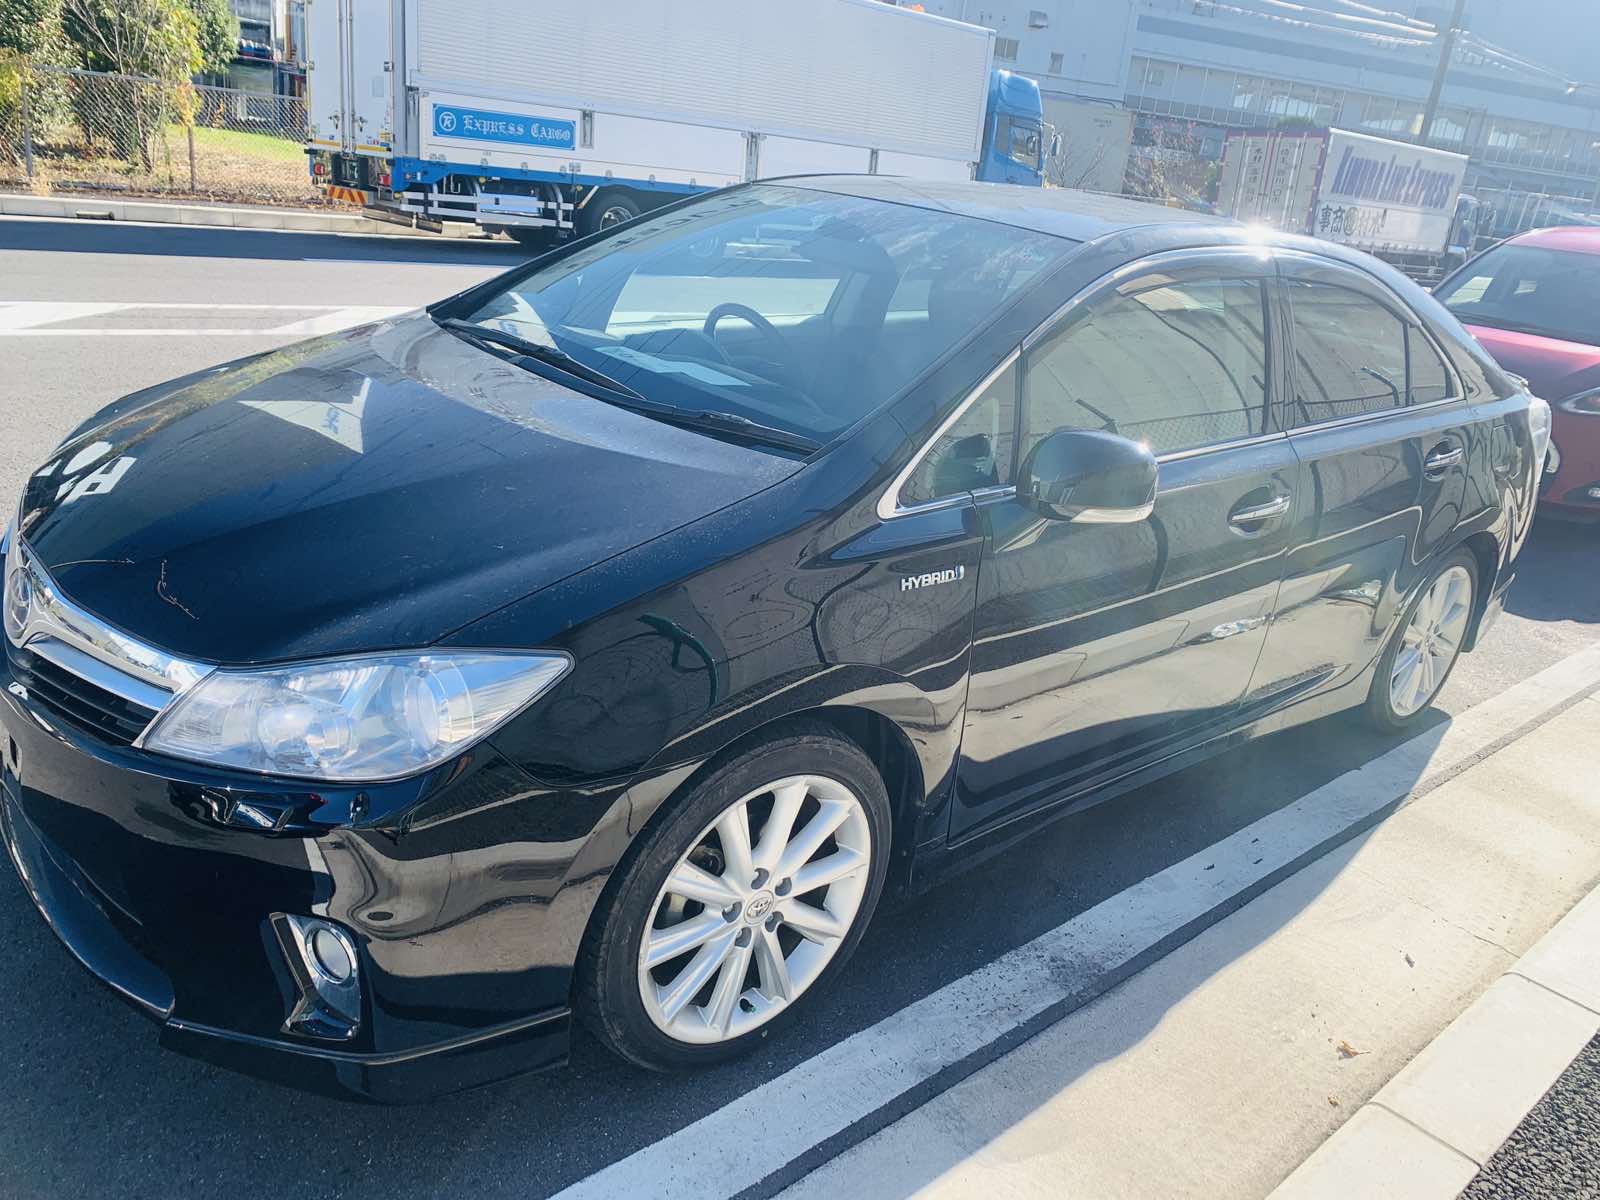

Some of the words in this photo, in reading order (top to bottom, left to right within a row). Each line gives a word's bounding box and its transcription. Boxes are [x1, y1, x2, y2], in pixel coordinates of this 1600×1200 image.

[463, 114, 525, 136] EXPRESS
[530, 123, 571, 141] CARGO
[901, 569, 955, 591] HYBRID
